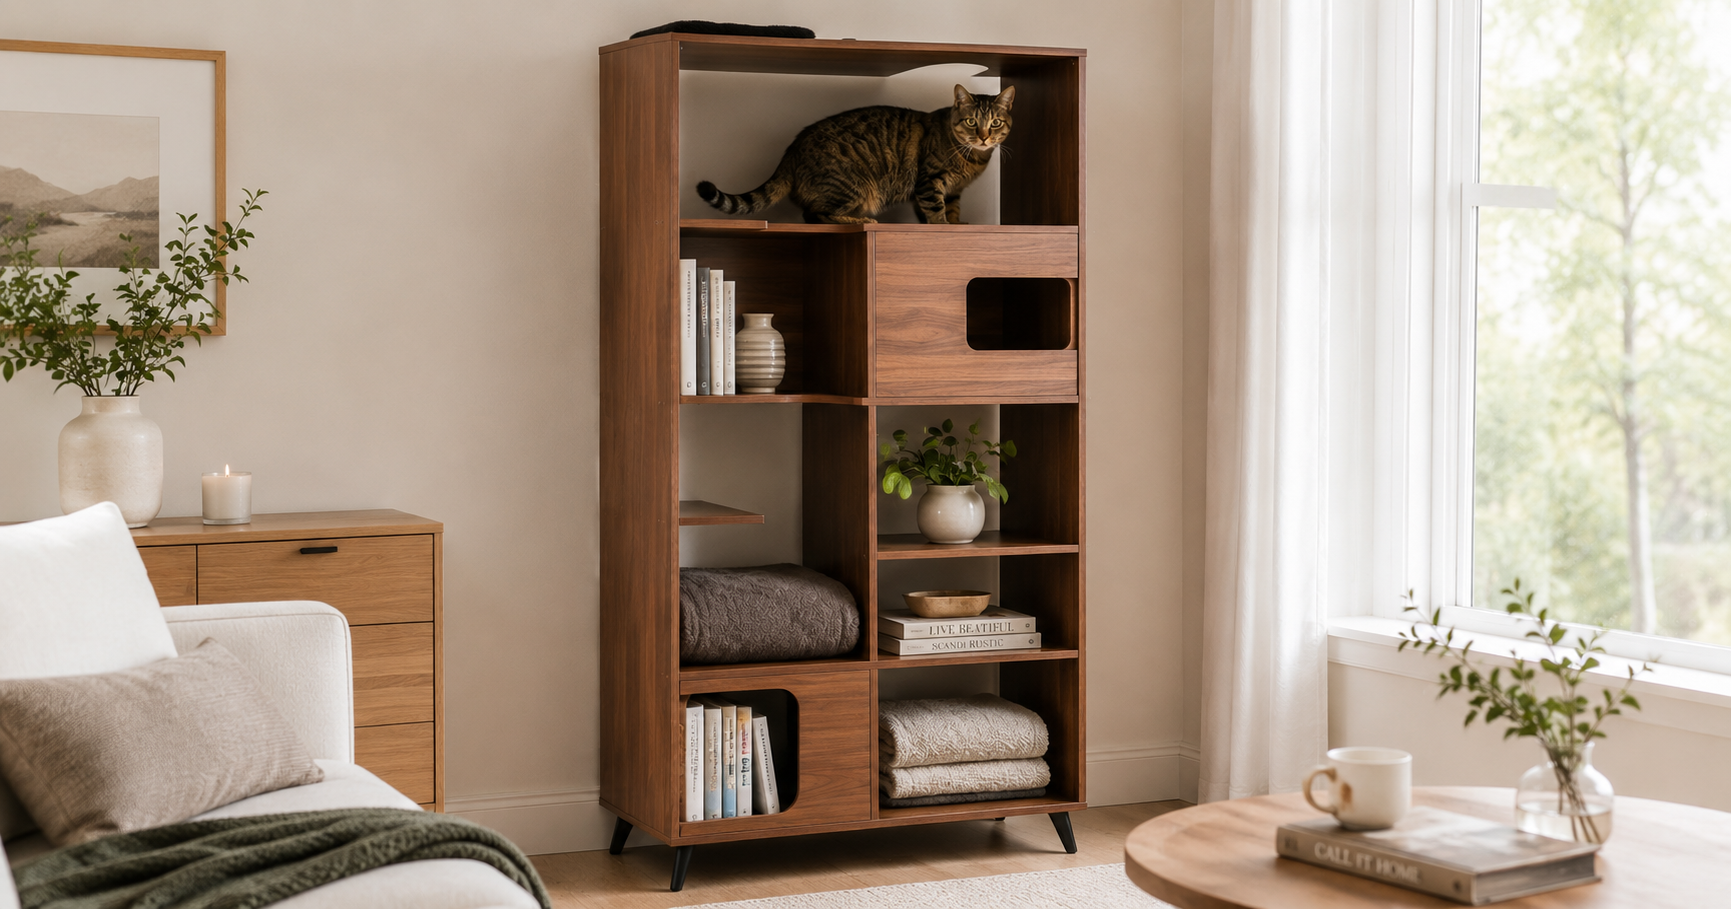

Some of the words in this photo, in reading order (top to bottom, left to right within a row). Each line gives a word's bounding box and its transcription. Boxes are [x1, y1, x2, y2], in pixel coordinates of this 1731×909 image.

[929, 624, 955, 636] LIVE
[959, 622, 1014, 634] BEATIFUL
[969, 638, 1004, 648] RUSTIC
[1314, 842, 1353, 867] CALL
[1355, 852, 1373, 871] IT
[1376, 857, 1422, 884] HOME
